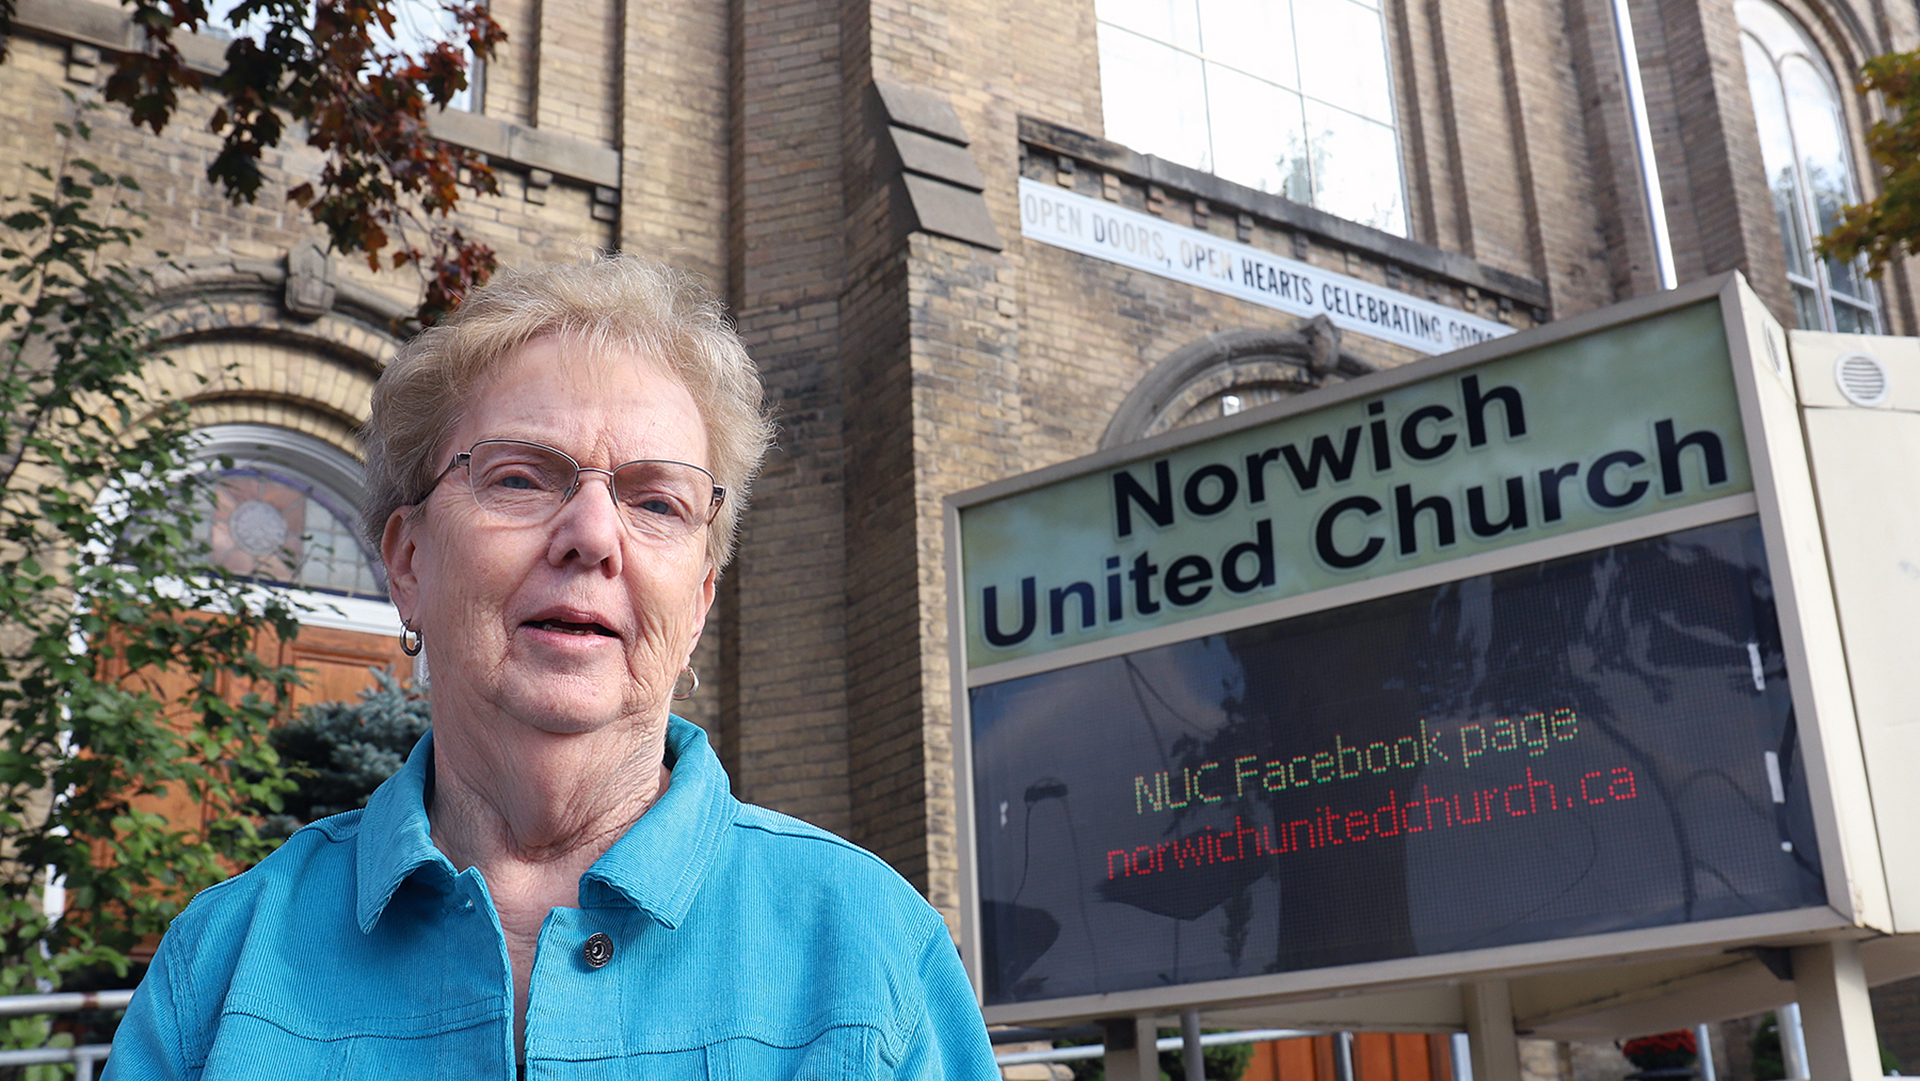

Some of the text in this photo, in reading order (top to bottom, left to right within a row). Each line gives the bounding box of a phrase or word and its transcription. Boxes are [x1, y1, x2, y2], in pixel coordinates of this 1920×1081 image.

[1024, 193, 1083, 237] OPEN
[1093, 213, 1171, 268] DOORS,
[1180, 238, 1234, 282] OPEN
[1241, 258, 1314, 305] HEARTS
[1322, 282, 1443, 343] CELEBRATING
[1112, 375, 1527, 538] Norwich
[981, 418, 1728, 648] United Church
[1106, 766, 1637, 880] norwichunitedchurch.ca
[1134, 707, 1579, 814] NUC Facebook page
